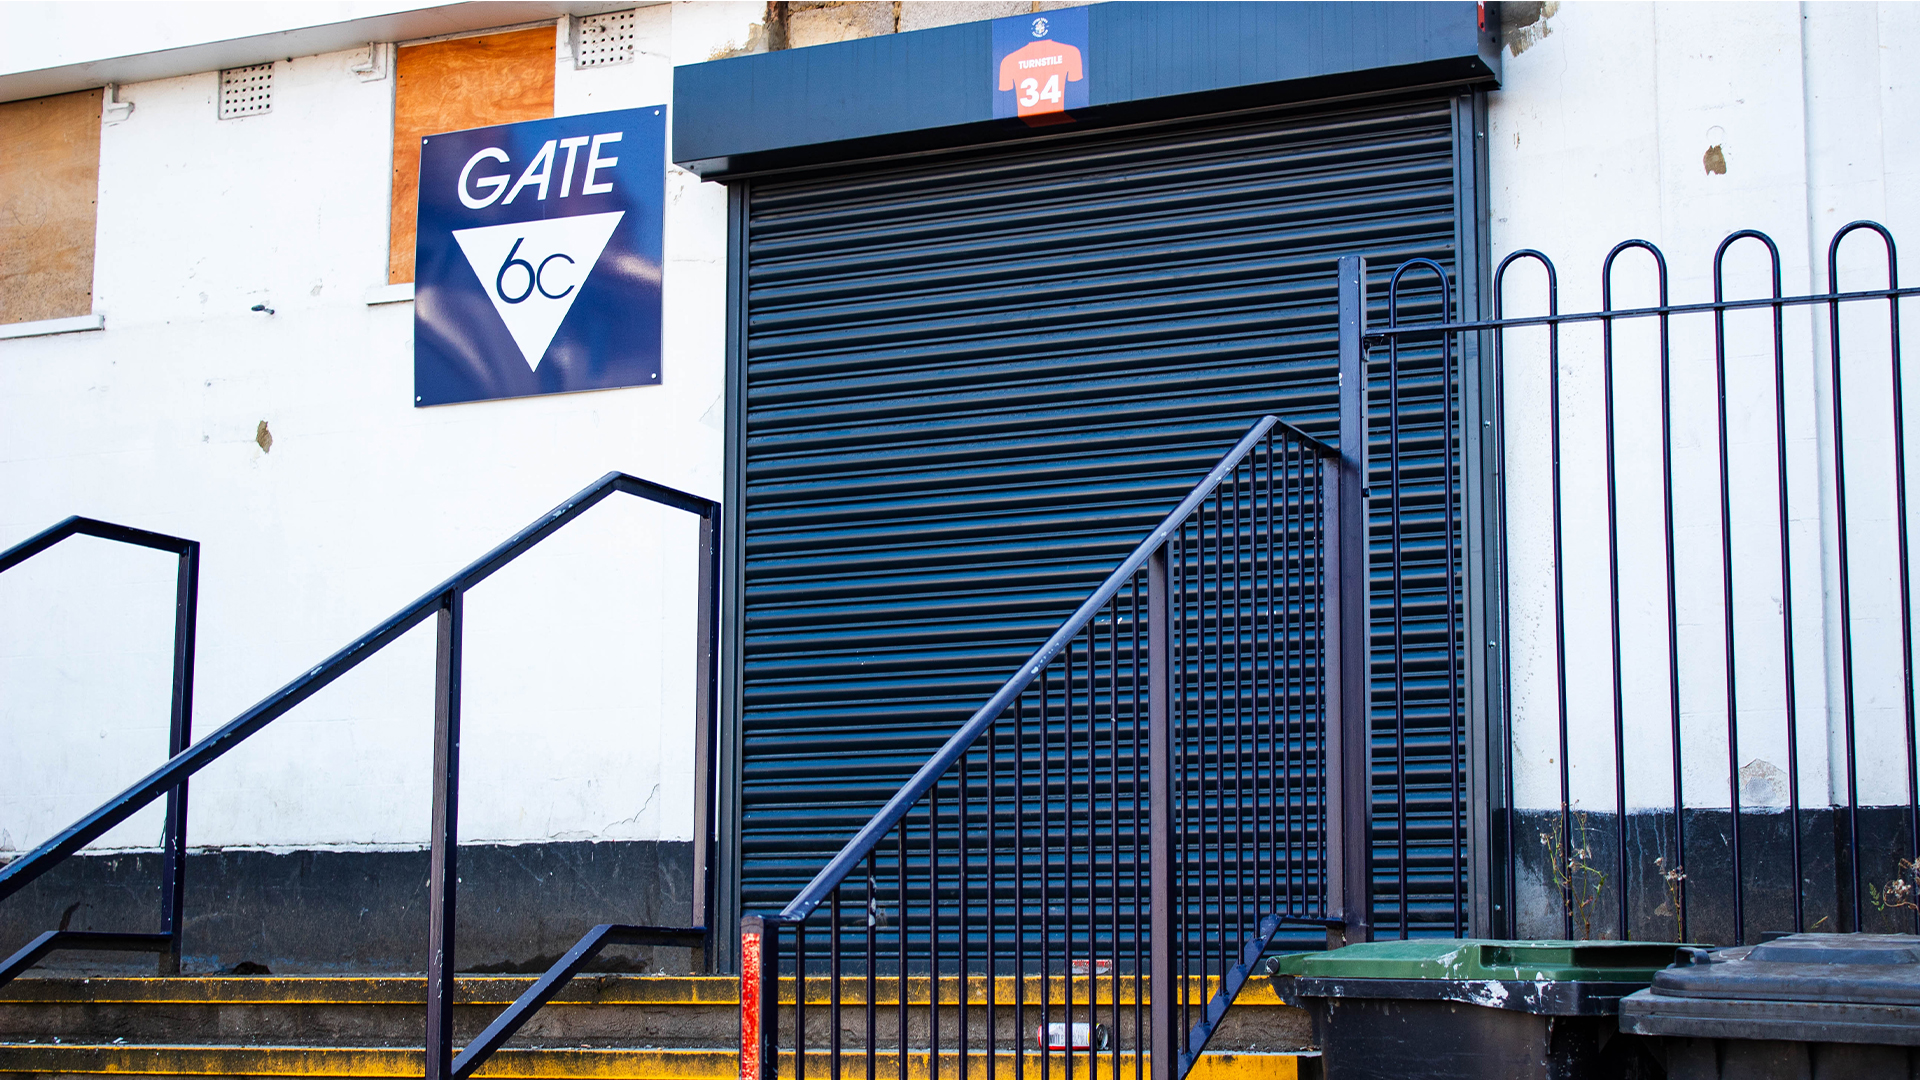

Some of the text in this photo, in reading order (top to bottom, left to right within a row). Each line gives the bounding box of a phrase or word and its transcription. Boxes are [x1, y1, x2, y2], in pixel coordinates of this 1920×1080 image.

[1018, 55, 1063, 70] TURNSTILE
[1019, 74, 1062, 108] 34
[457, 132, 623, 210] GATE
